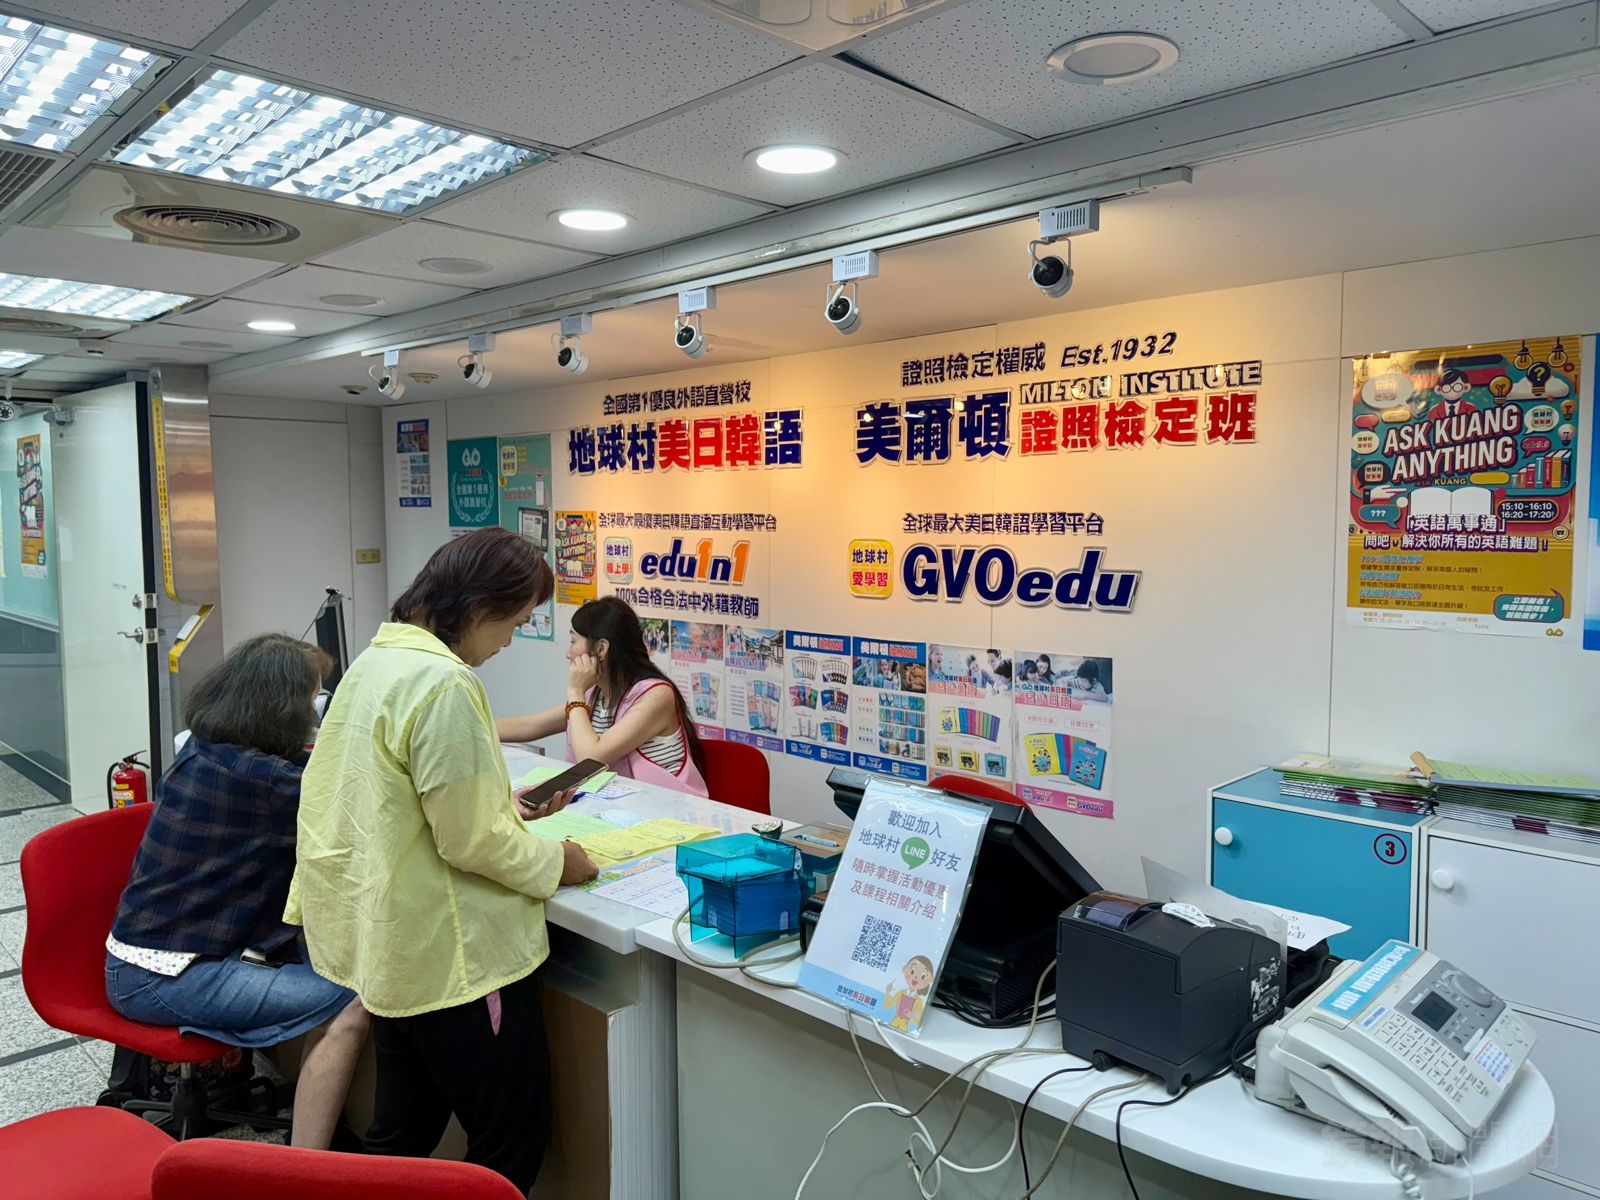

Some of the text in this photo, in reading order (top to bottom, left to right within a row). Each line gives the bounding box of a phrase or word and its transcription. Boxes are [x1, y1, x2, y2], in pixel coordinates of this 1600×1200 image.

[902, 331, 1177, 386] 證照檢定權威 Est.1932
[603, 381, 752, 416] 全國第1優良外語直營校
[1019, 360, 1262, 404] MILTON INSTITUTE
[567, 408, 803, 474] 地球村美日韓語
[855, 388, 1011, 466] 美爾頓
[1019, 392, 1257, 455] 證照檢定班
[1384, 405, 1519, 453] ASK KUANG
[1392, 436, 1513, 480] ANYTHING
[1435, 478, 1466, 486] KUANG
[903, 512, 1104, 535] 全球最大美日韓語學習平台
[607, 544, 629, 556] 地球村
[852, 549, 889, 564] 地球村
[852, 571, 889, 587] 愛學習
[902, 544, 1140, 610] GVOedu
[887, 809, 942, 838] 歡迎加入
[858, 828, 962, 872] 地球村 LINE 好友
[1385, 841, 1395, 857] 3
[852, 857, 950, 899] 隨時掌握活動優惠
[850, 879, 937, 920] 及課程相關介紹
